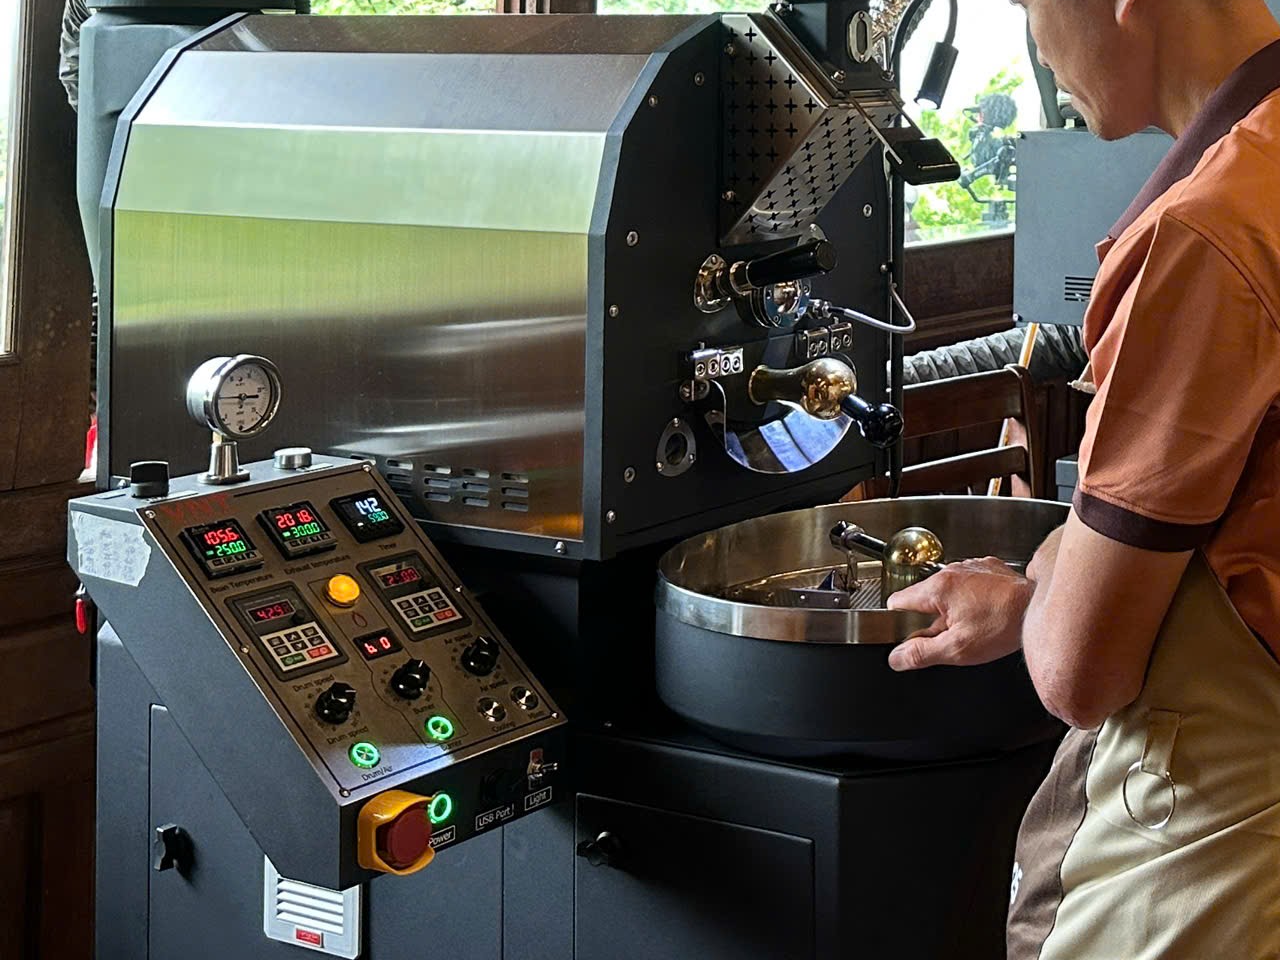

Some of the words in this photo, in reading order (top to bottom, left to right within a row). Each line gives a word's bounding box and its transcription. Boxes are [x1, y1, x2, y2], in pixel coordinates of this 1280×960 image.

[326, 733, 349, 745] Drum
[349, 725, 369, 738] speed
[361, 765, 393, 781] Drum/Air
[528, 790, 547, 806] Light
[478, 813, 494, 826] USB
[495, 806, 511, 820] Port
